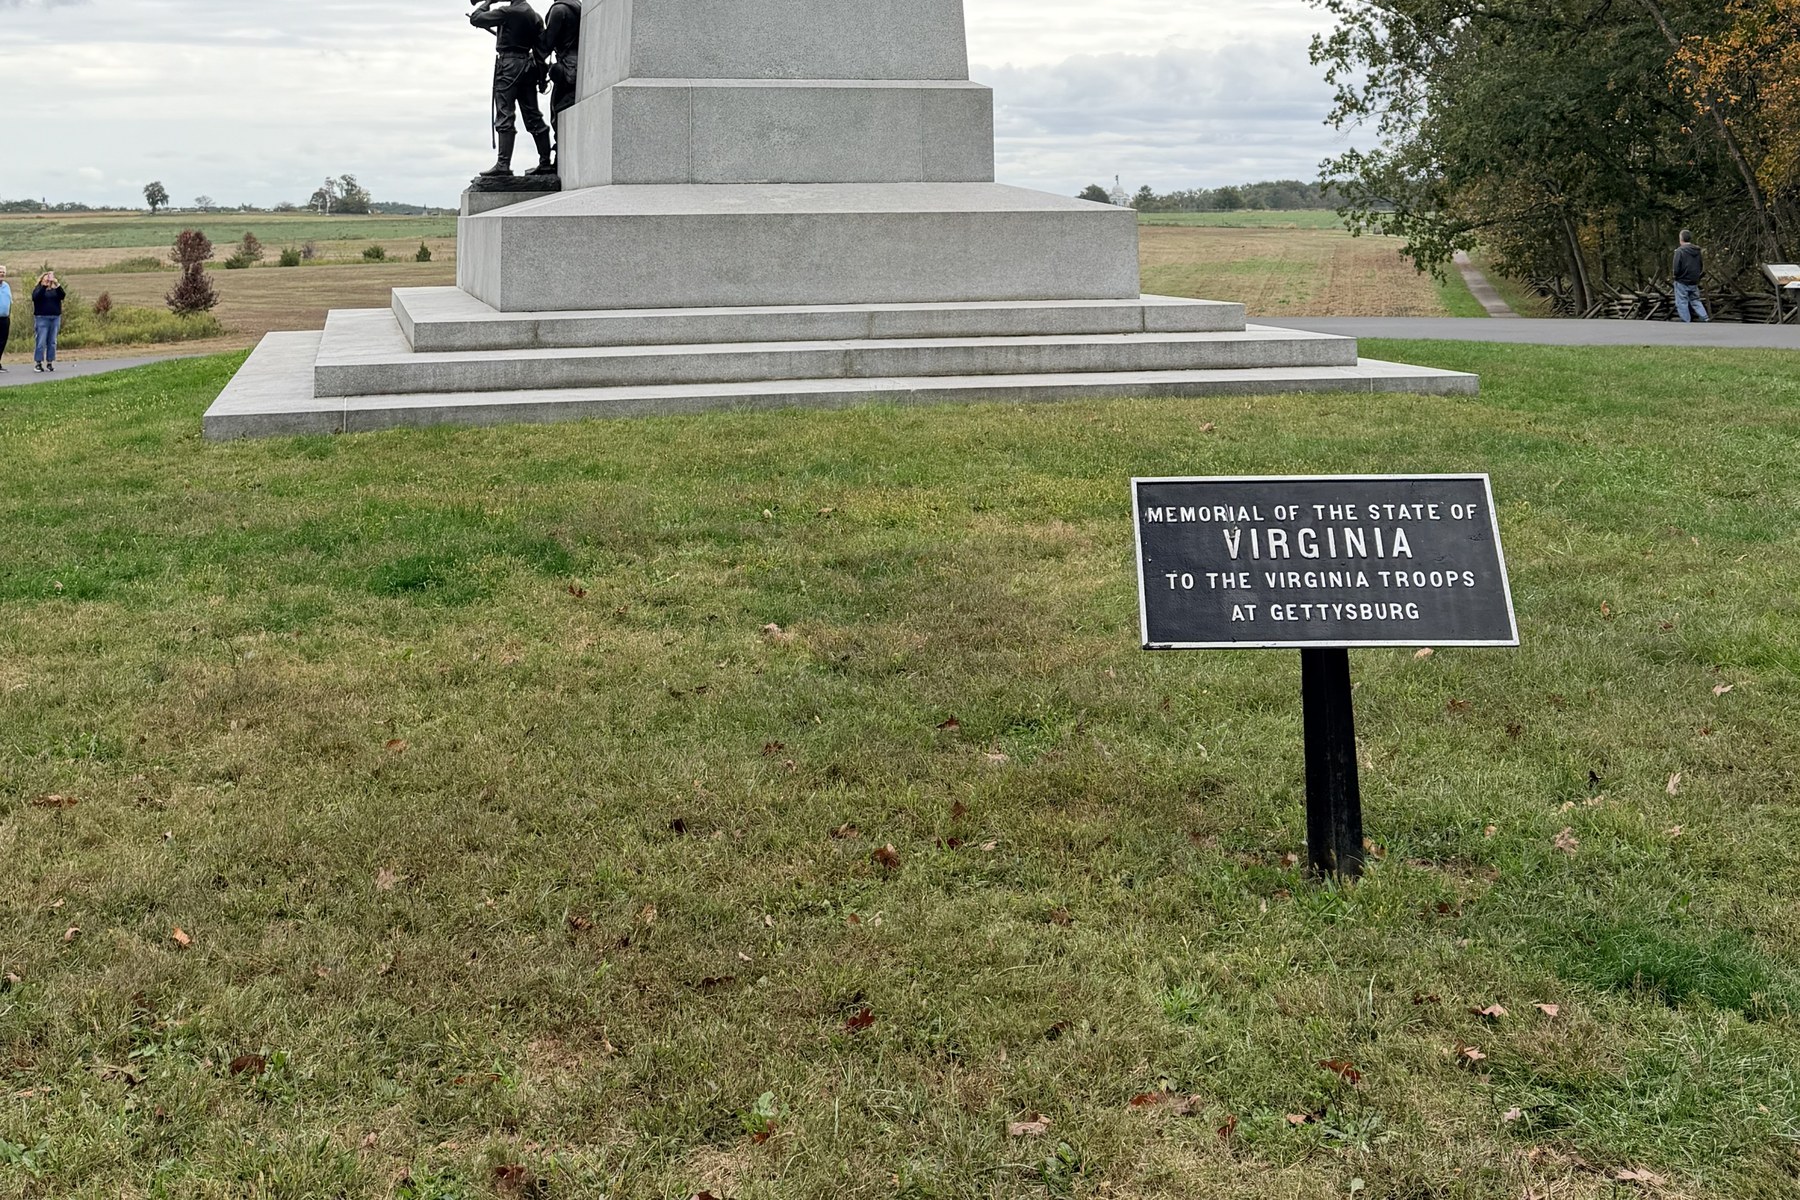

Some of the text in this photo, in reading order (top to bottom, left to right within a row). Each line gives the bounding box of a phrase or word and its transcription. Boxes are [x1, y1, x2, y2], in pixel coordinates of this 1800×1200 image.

[1147, 503, 1477, 523] MEMORIAL OF THE STATE OF
[1222, 526, 1413, 559] VIRGINIA
[1165, 570, 1475, 590] TO THE VIRGINIA TROOPS
[1231, 602, 1420, 622] AT GETTYSBURG
